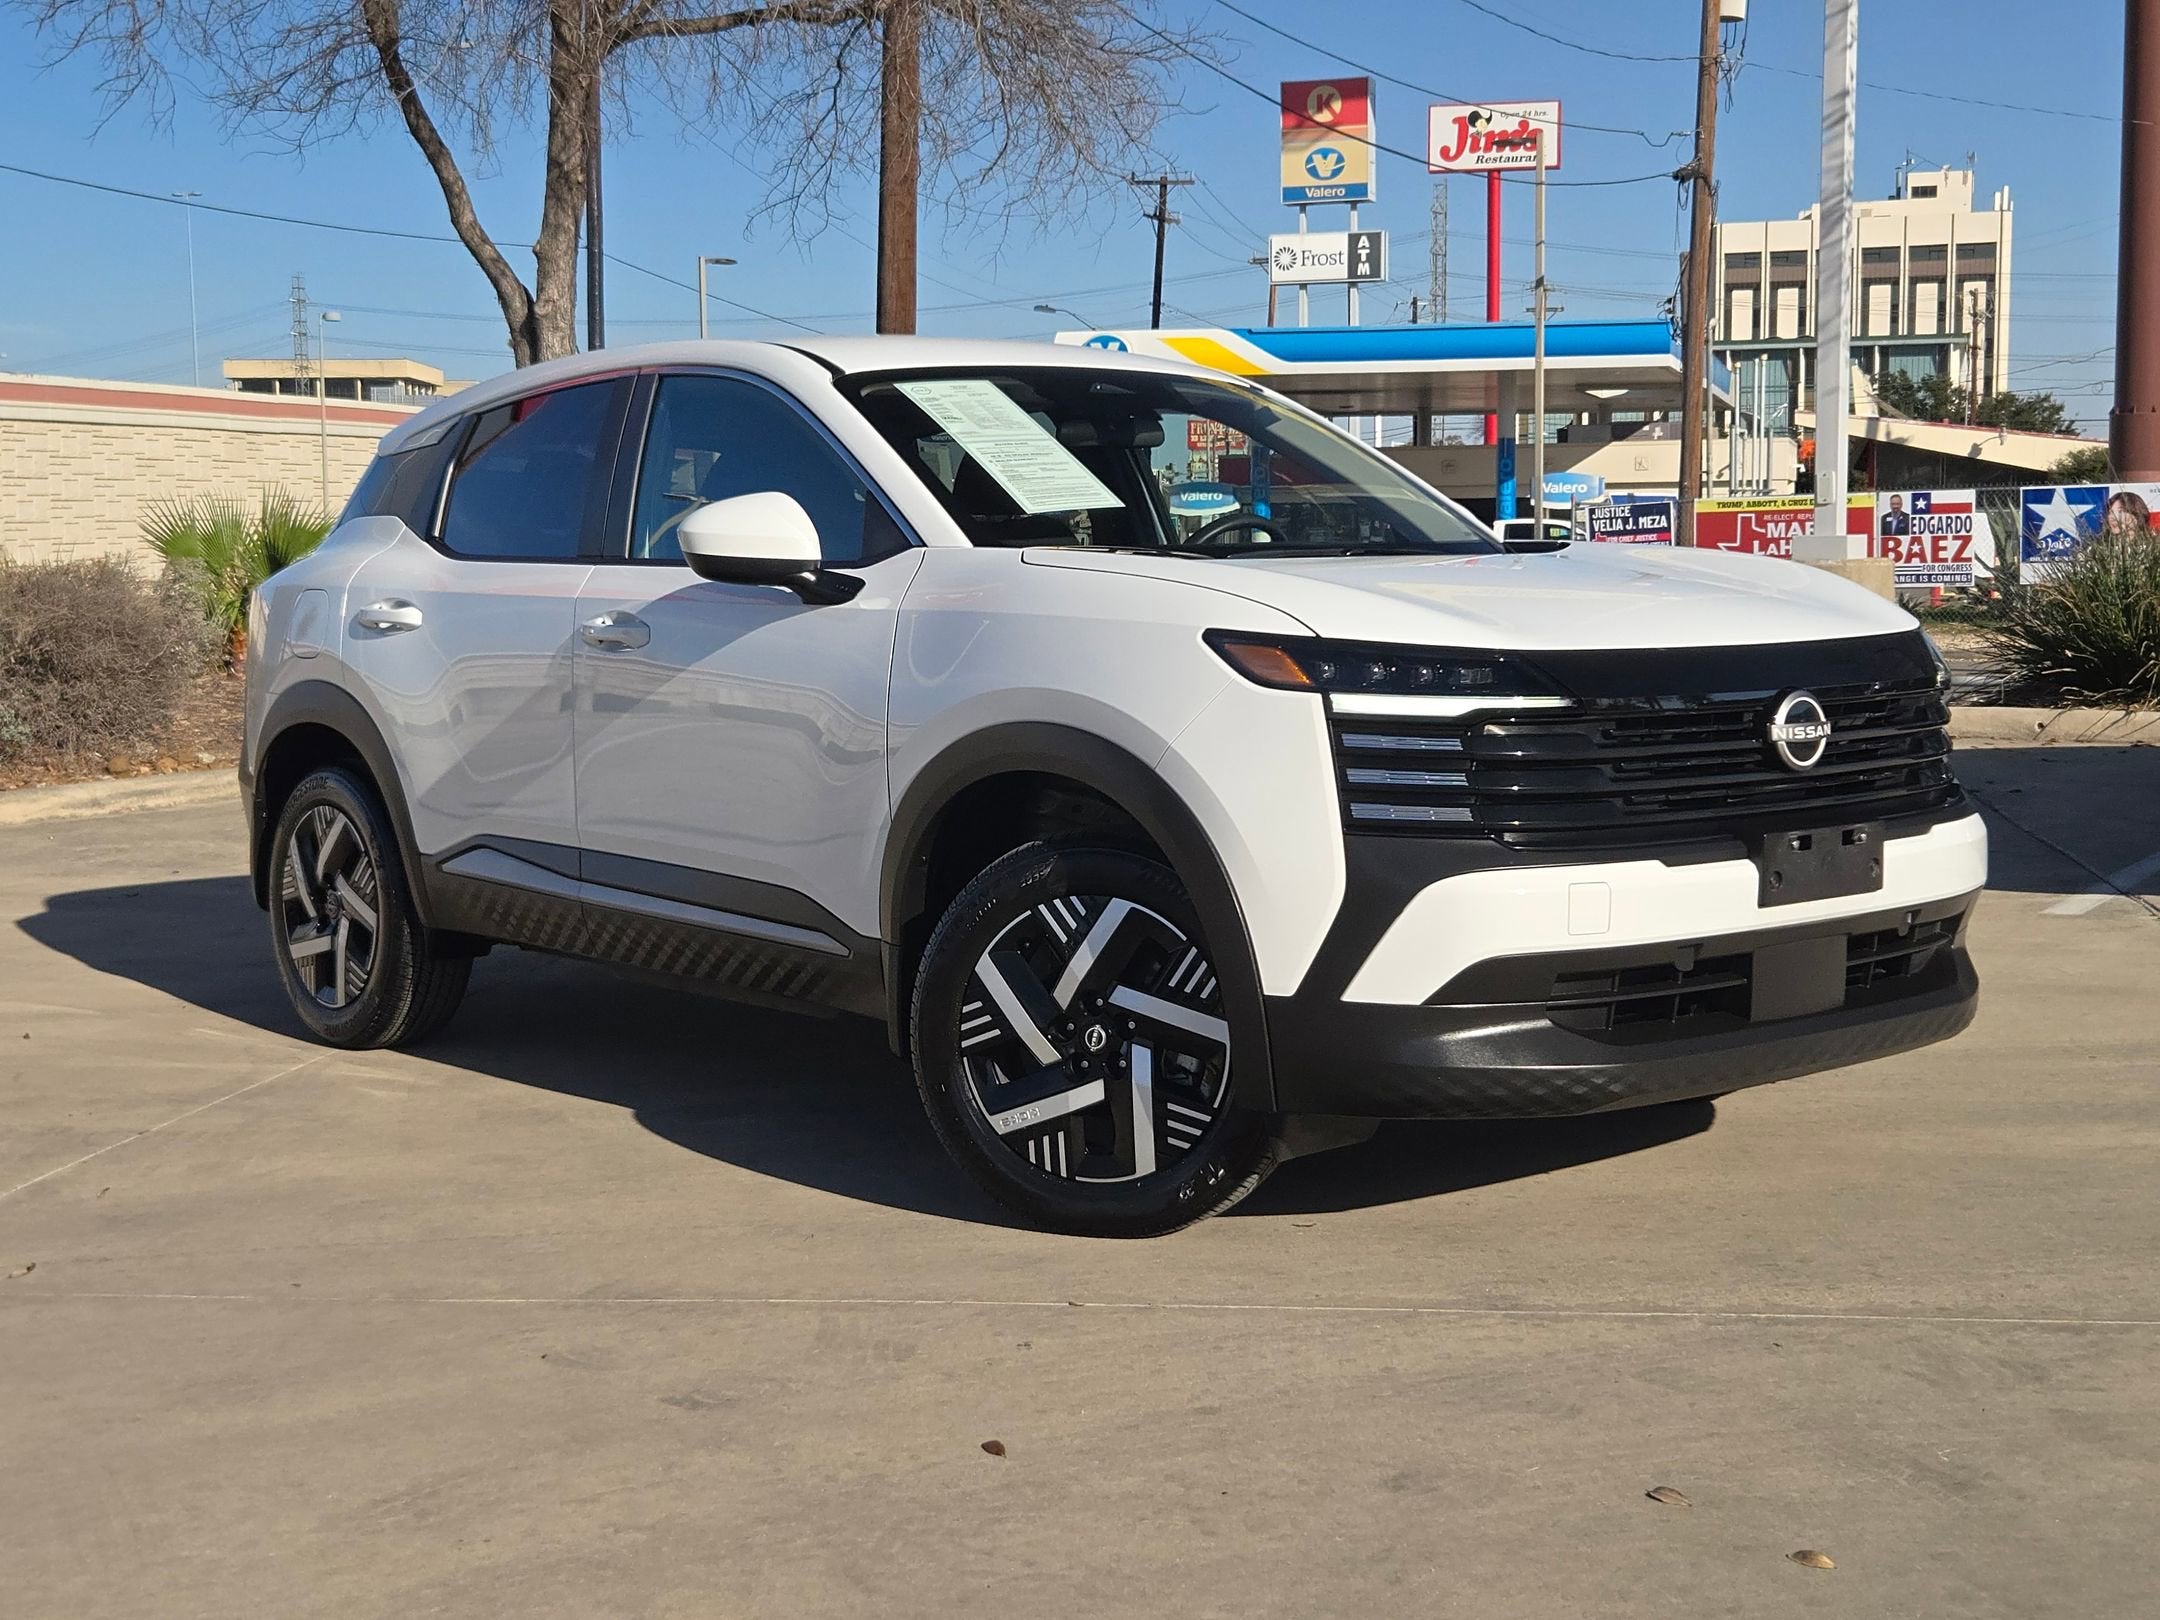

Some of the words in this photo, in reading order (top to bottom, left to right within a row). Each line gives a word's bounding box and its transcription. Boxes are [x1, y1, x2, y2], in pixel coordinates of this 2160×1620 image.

[1305, 187, 1346, 198] Valero
[1300, 250, 1345, 267] Frost
[1357, 235, 1371, 276] ATM
[1543, 482, 1588, 494] Valero
[1592, 506, 1631, 519] JUSTICE
[1717, 502, 1745, 510] TRUMP,
[1746, 500, 1780, 508] ABBOTT,
[1592, 519, 1624, 532] VELIA
[1626, 518, 1636, 530] J.
[1639, 515, 1668, 529] MEZA
[1910, 515, 1973, 535] EDGARDO
[1880, 534, 1973, 564] BAEZ
[1937, 564, 1973, 572] CONGRESS
[1931, 574, 1971, 582] COMING!
[1771, 722, 1831, 740] NISSAN
